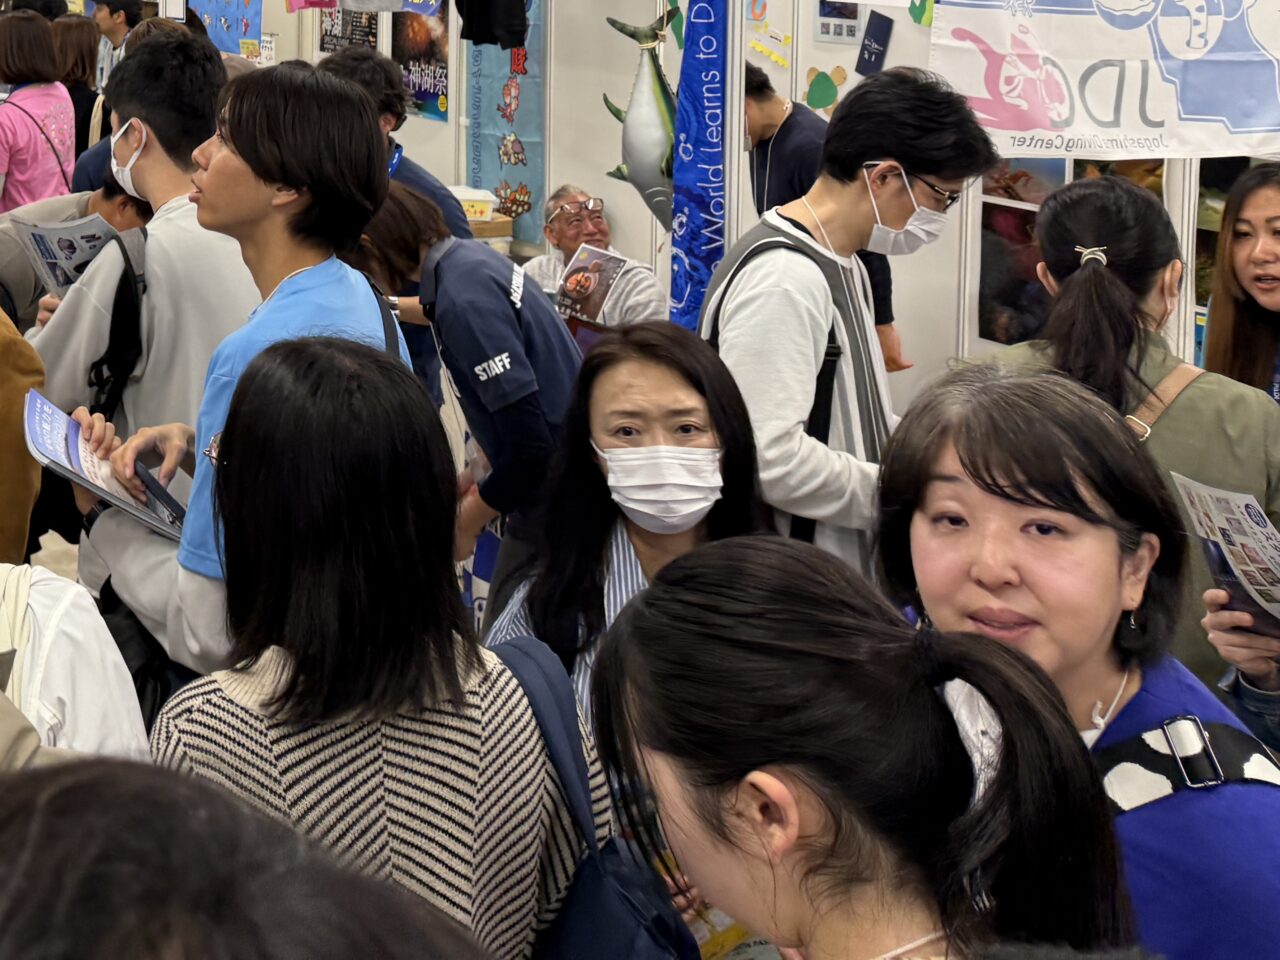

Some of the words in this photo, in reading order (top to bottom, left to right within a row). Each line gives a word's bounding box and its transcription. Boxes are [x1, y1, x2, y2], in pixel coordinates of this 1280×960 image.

[695, 38, 719, 61] to
[699, 66, 723, 149] Learns
[698, 150, 726, 250] World
[474, 352, 512, 382] STAFF
